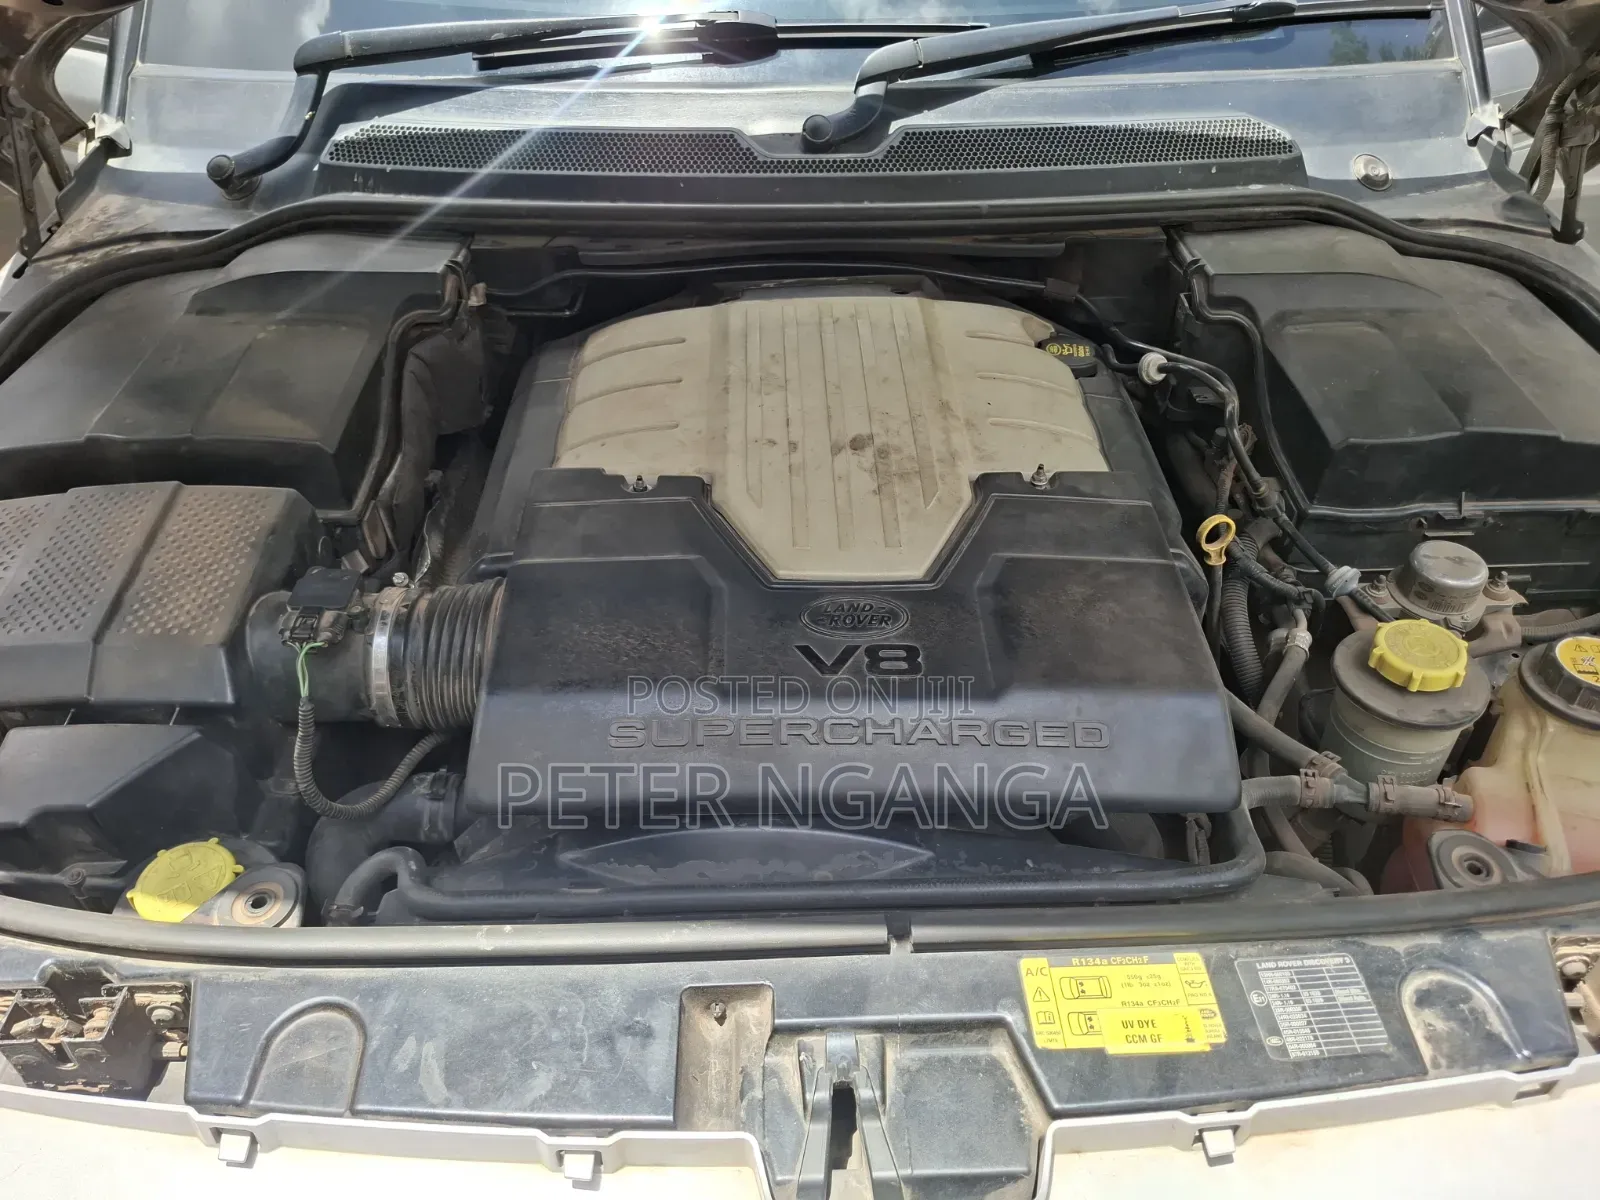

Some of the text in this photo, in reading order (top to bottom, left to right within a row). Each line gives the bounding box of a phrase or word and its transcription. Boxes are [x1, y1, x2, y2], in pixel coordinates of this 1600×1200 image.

[823, 602, 875, 614] LAND
[827, 614, 893, 628] ROVER
[793, 643, 924, 678] V8
[607, 717, 1111, 749] SUPERCHARGED
[1071, 957, 1109, 966] R134a
[1256, 961, 1277, 970] LAND
[1278, 960, 1303, 968] ROVER
[1303, 957, 1344, 966] DISCOVERY
[1025, 966, 1049, 977] A/C
[1121, 1018, 1158, 1029] UV DYE
[1125, 1033, 1163, 1044] CCM GF
